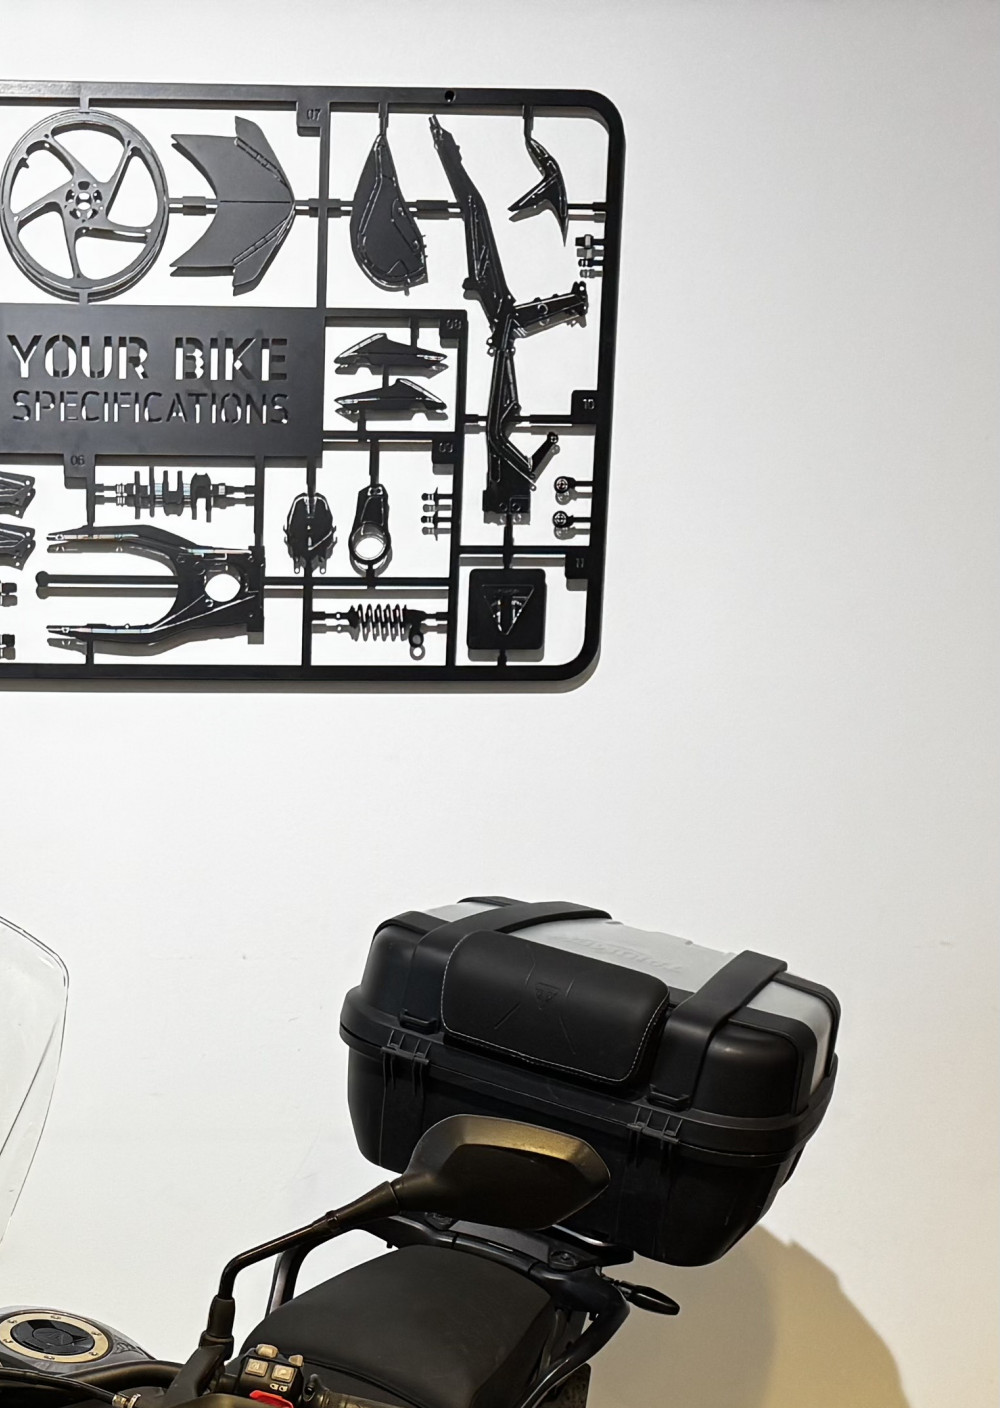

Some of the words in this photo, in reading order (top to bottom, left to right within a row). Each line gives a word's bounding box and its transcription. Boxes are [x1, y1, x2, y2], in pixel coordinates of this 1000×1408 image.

[306, 107, 322, 121] 07
[7, 334, 148, 380] YOUR
[175, 337, 288, 381] BIKE
[12, 390, 289, 424] SPECIFICATIONS
[582, 397, 596, 410] 10
[70, 454, 86, 468] 06
